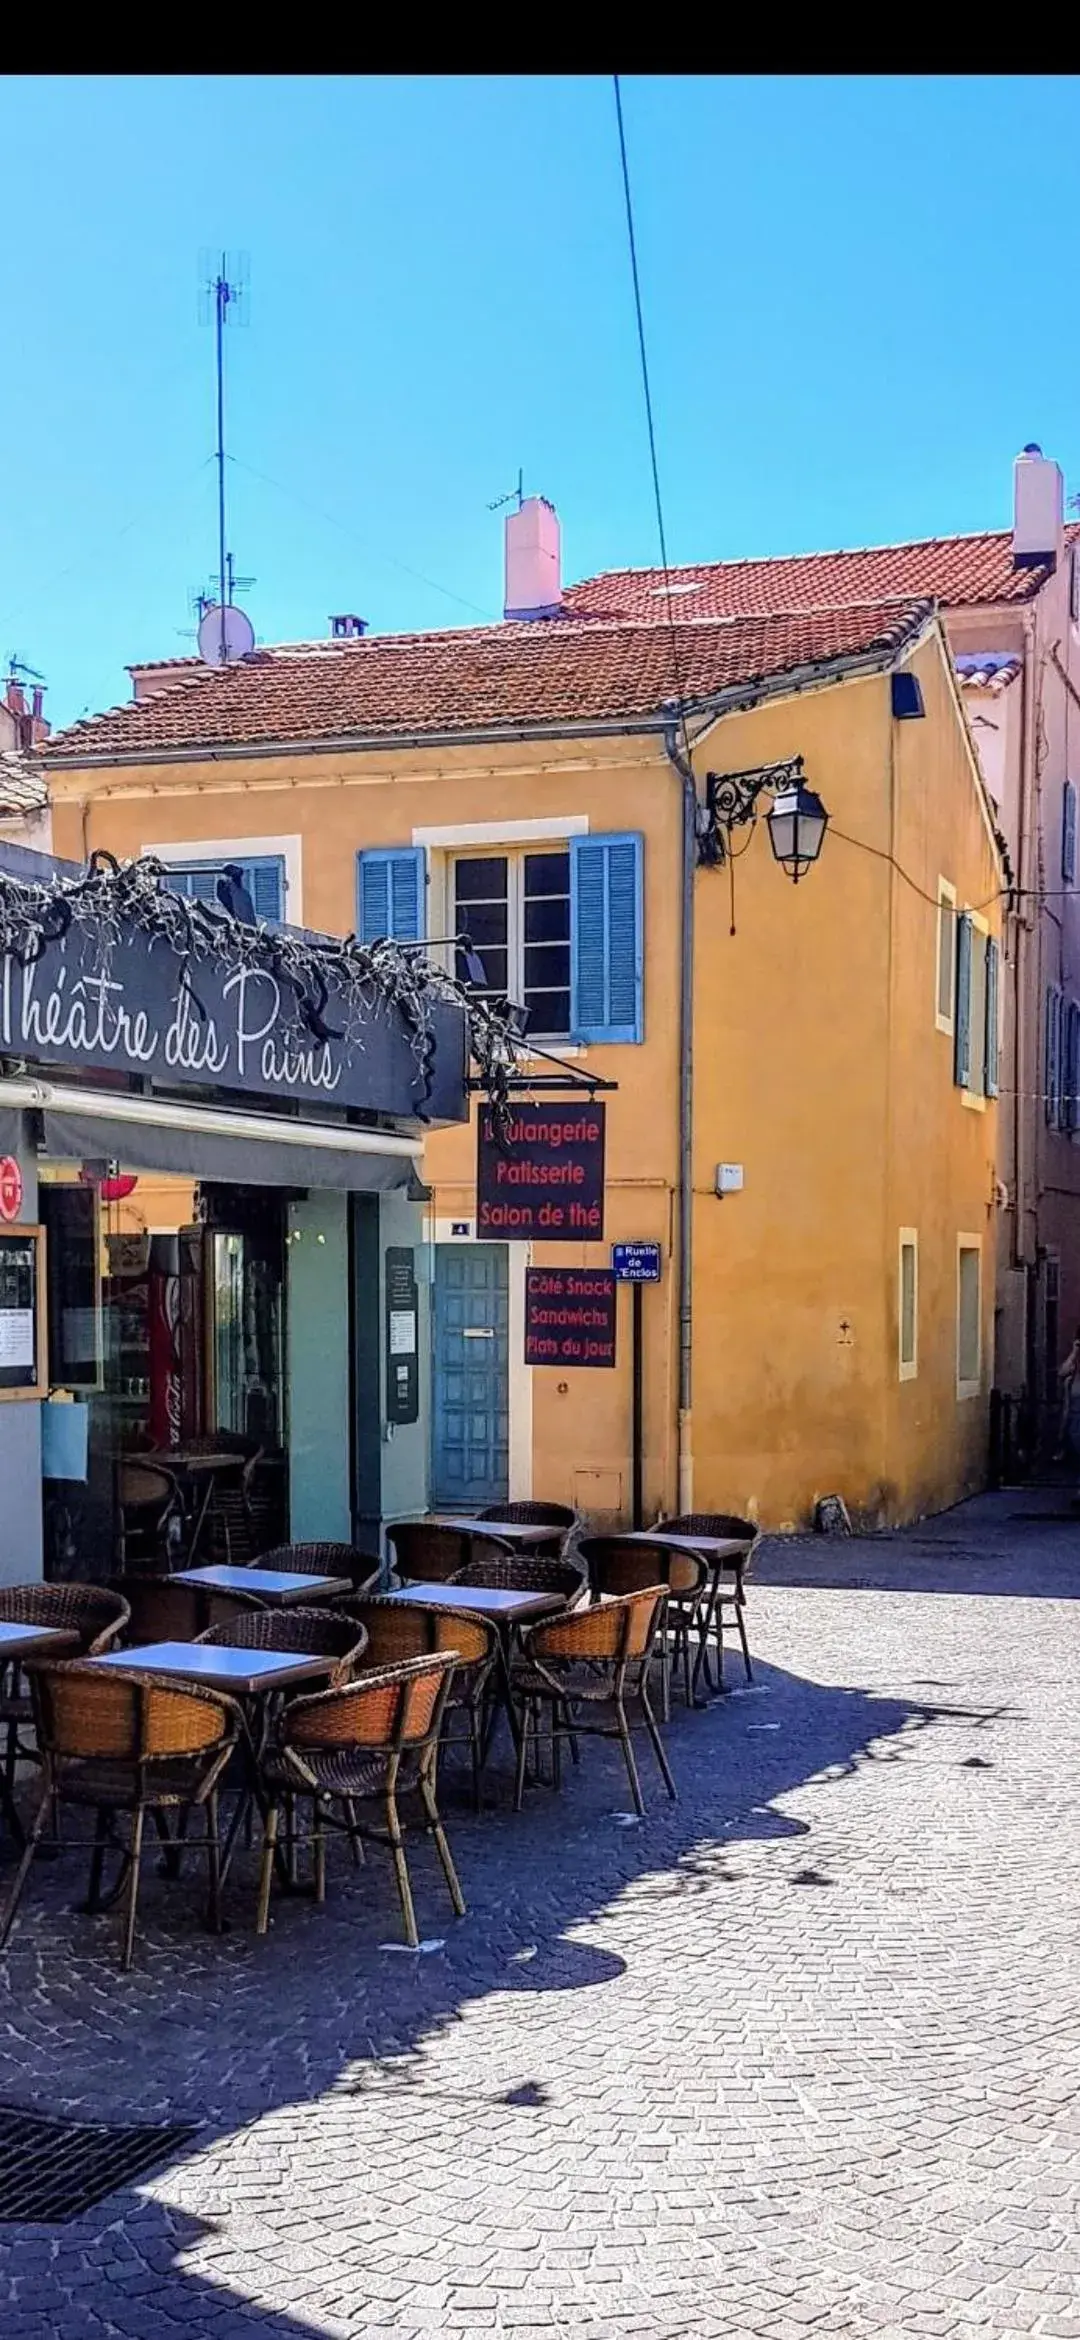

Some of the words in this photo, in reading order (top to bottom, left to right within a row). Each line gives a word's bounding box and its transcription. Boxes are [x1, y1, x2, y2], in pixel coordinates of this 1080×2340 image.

[0, 927, 158, 1061] Théâtre
[165, 970, 230, 1073] des
[222, 961, 342, 1090] Pains
[484, 1117, 600, 1147] ulangerie
[481, 1201, 533, 1226] Salon
[538, 1202, 564, 1226] de
[569, 1200, 601, 1226] thé
[625, 1246, 657, 1256] Ruelle
[628, 1257, 642, 1267] de
[616, 1267, 658, 1278] 'Enclos
[528, 1274, 563, 1294] Côté
[567, 1277, 612, 1296] Snack
[530, 1305, 609, 1326] Sandwichs
[527, 1335, 558, 1355] Plats
[562, 1338, 580, 1356] du
[583, 1338, 613, 1360] jour
